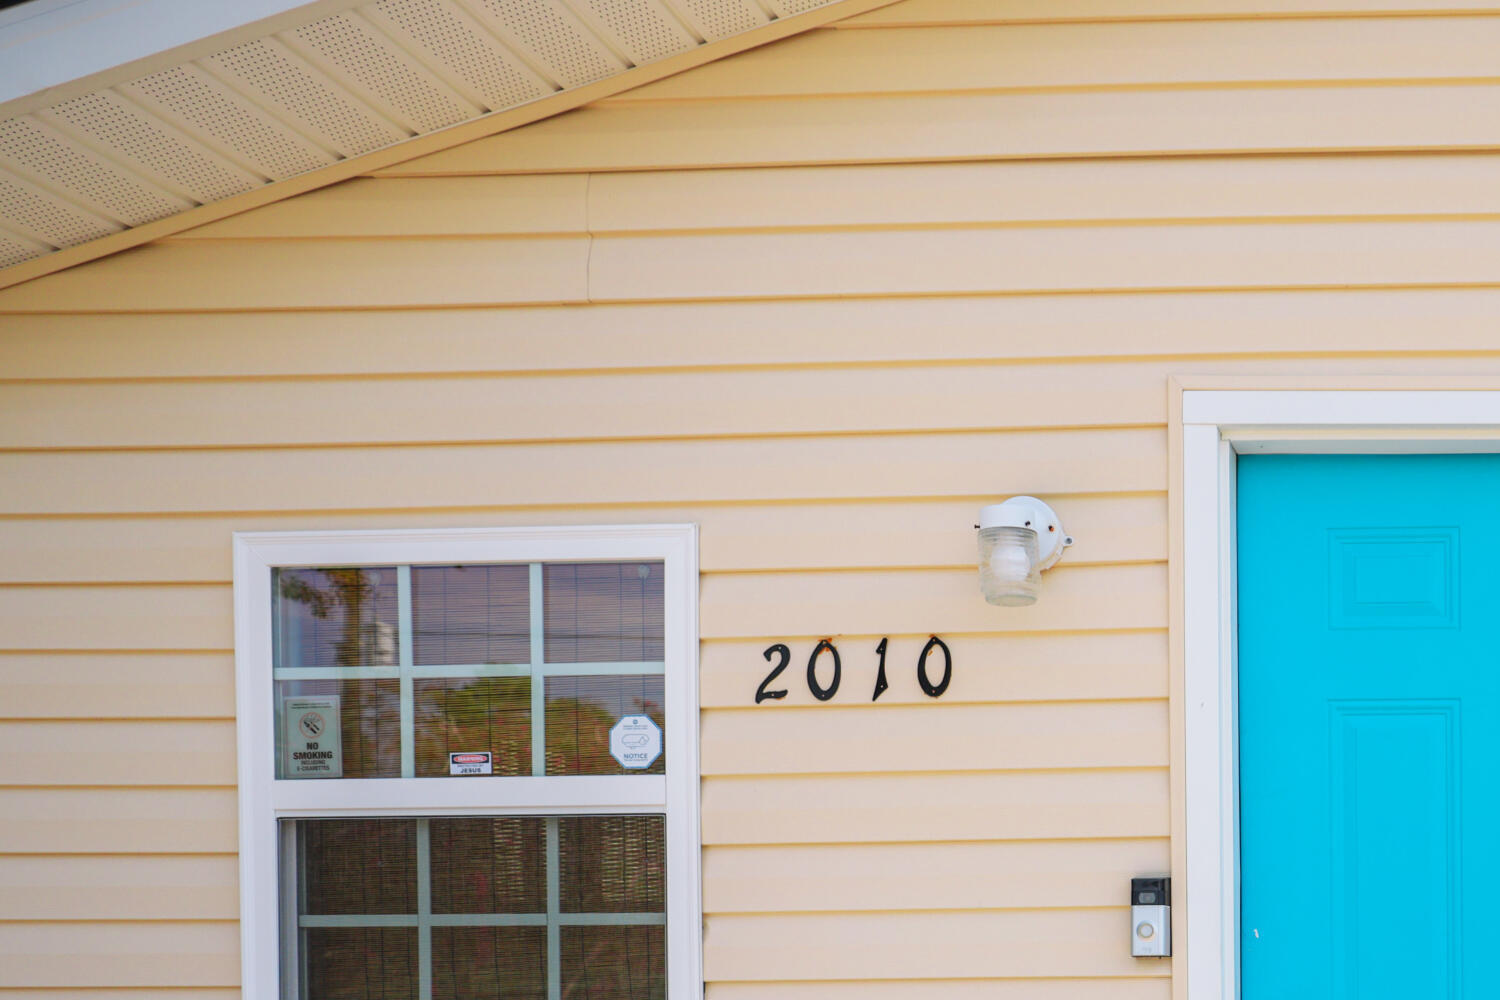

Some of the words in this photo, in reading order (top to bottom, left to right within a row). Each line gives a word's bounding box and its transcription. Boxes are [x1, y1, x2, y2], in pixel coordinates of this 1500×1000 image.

[755, 636, 952, 704] 2010
[306, 742, 319, 750] NO
[293, 751, 333, 760] SMOKING
